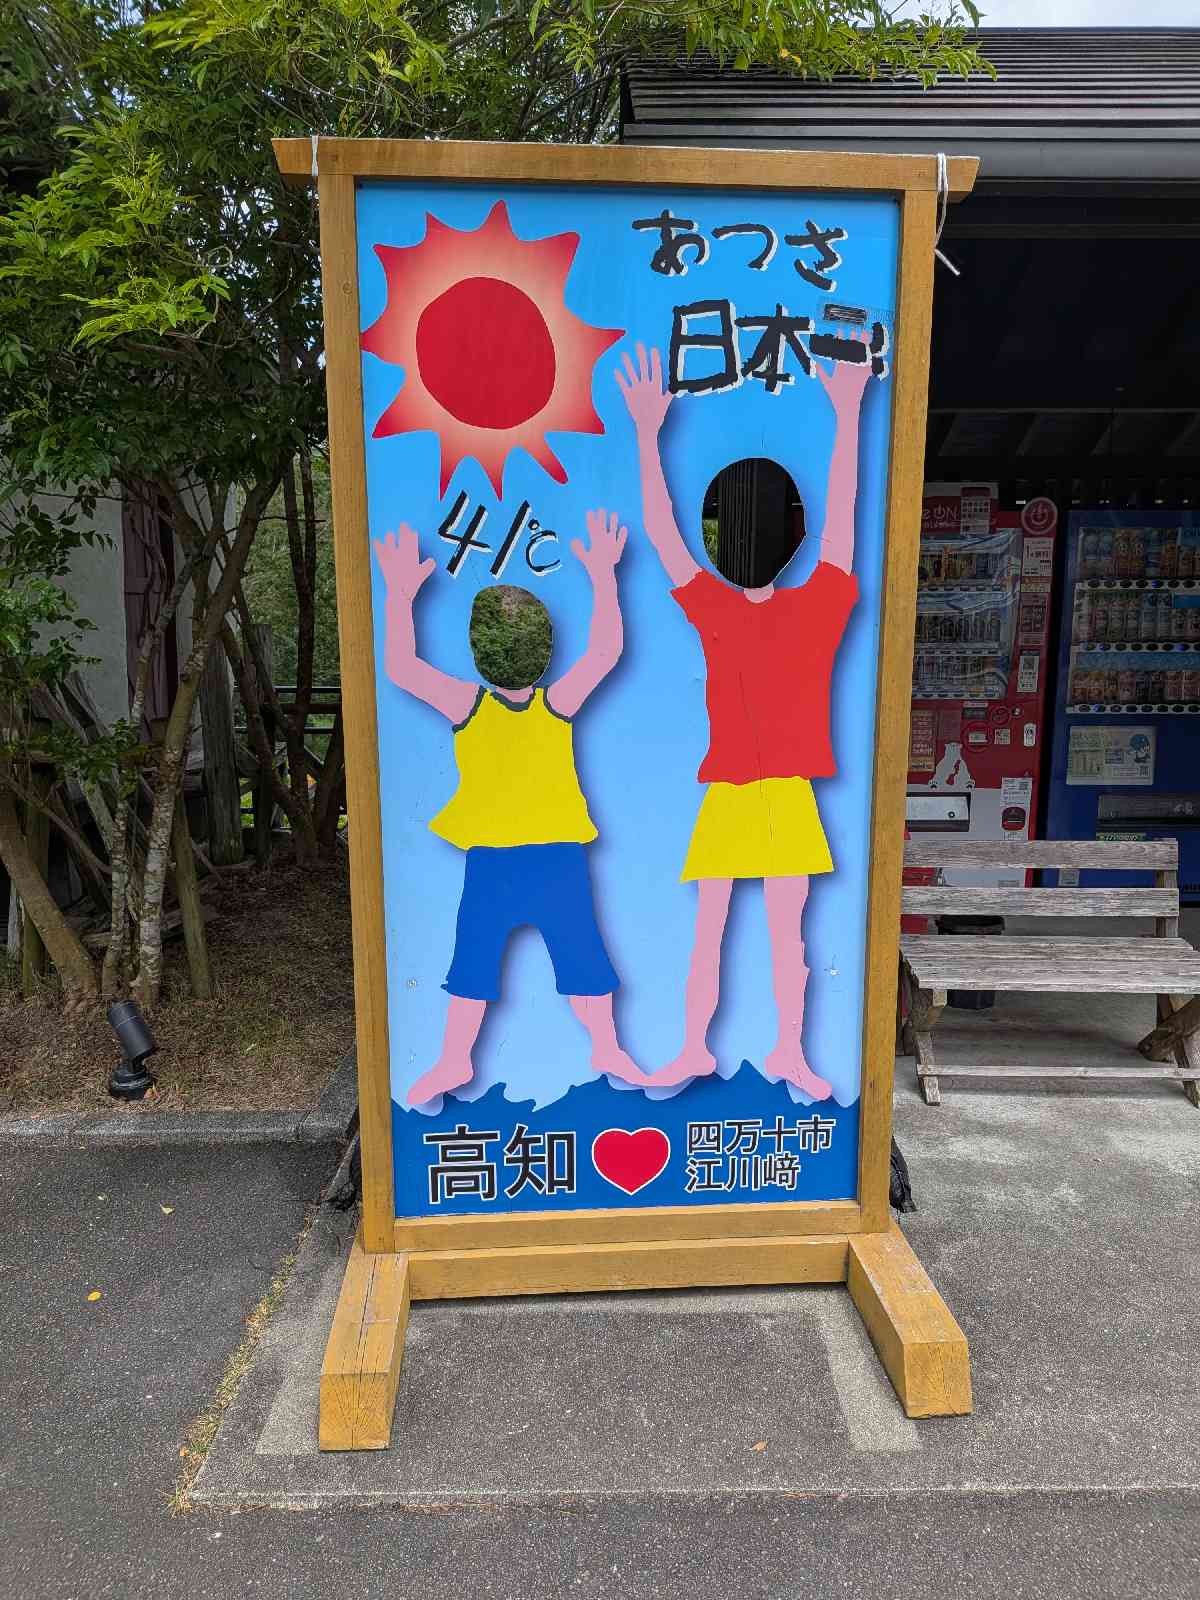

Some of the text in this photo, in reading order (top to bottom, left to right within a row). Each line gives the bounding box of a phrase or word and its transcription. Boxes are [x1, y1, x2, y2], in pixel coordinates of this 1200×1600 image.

[632, 209, 848, 291] あつさ
[422, 1123, 577, 1205] 高知
[686, 1114, 837, 1156] 四万十市
